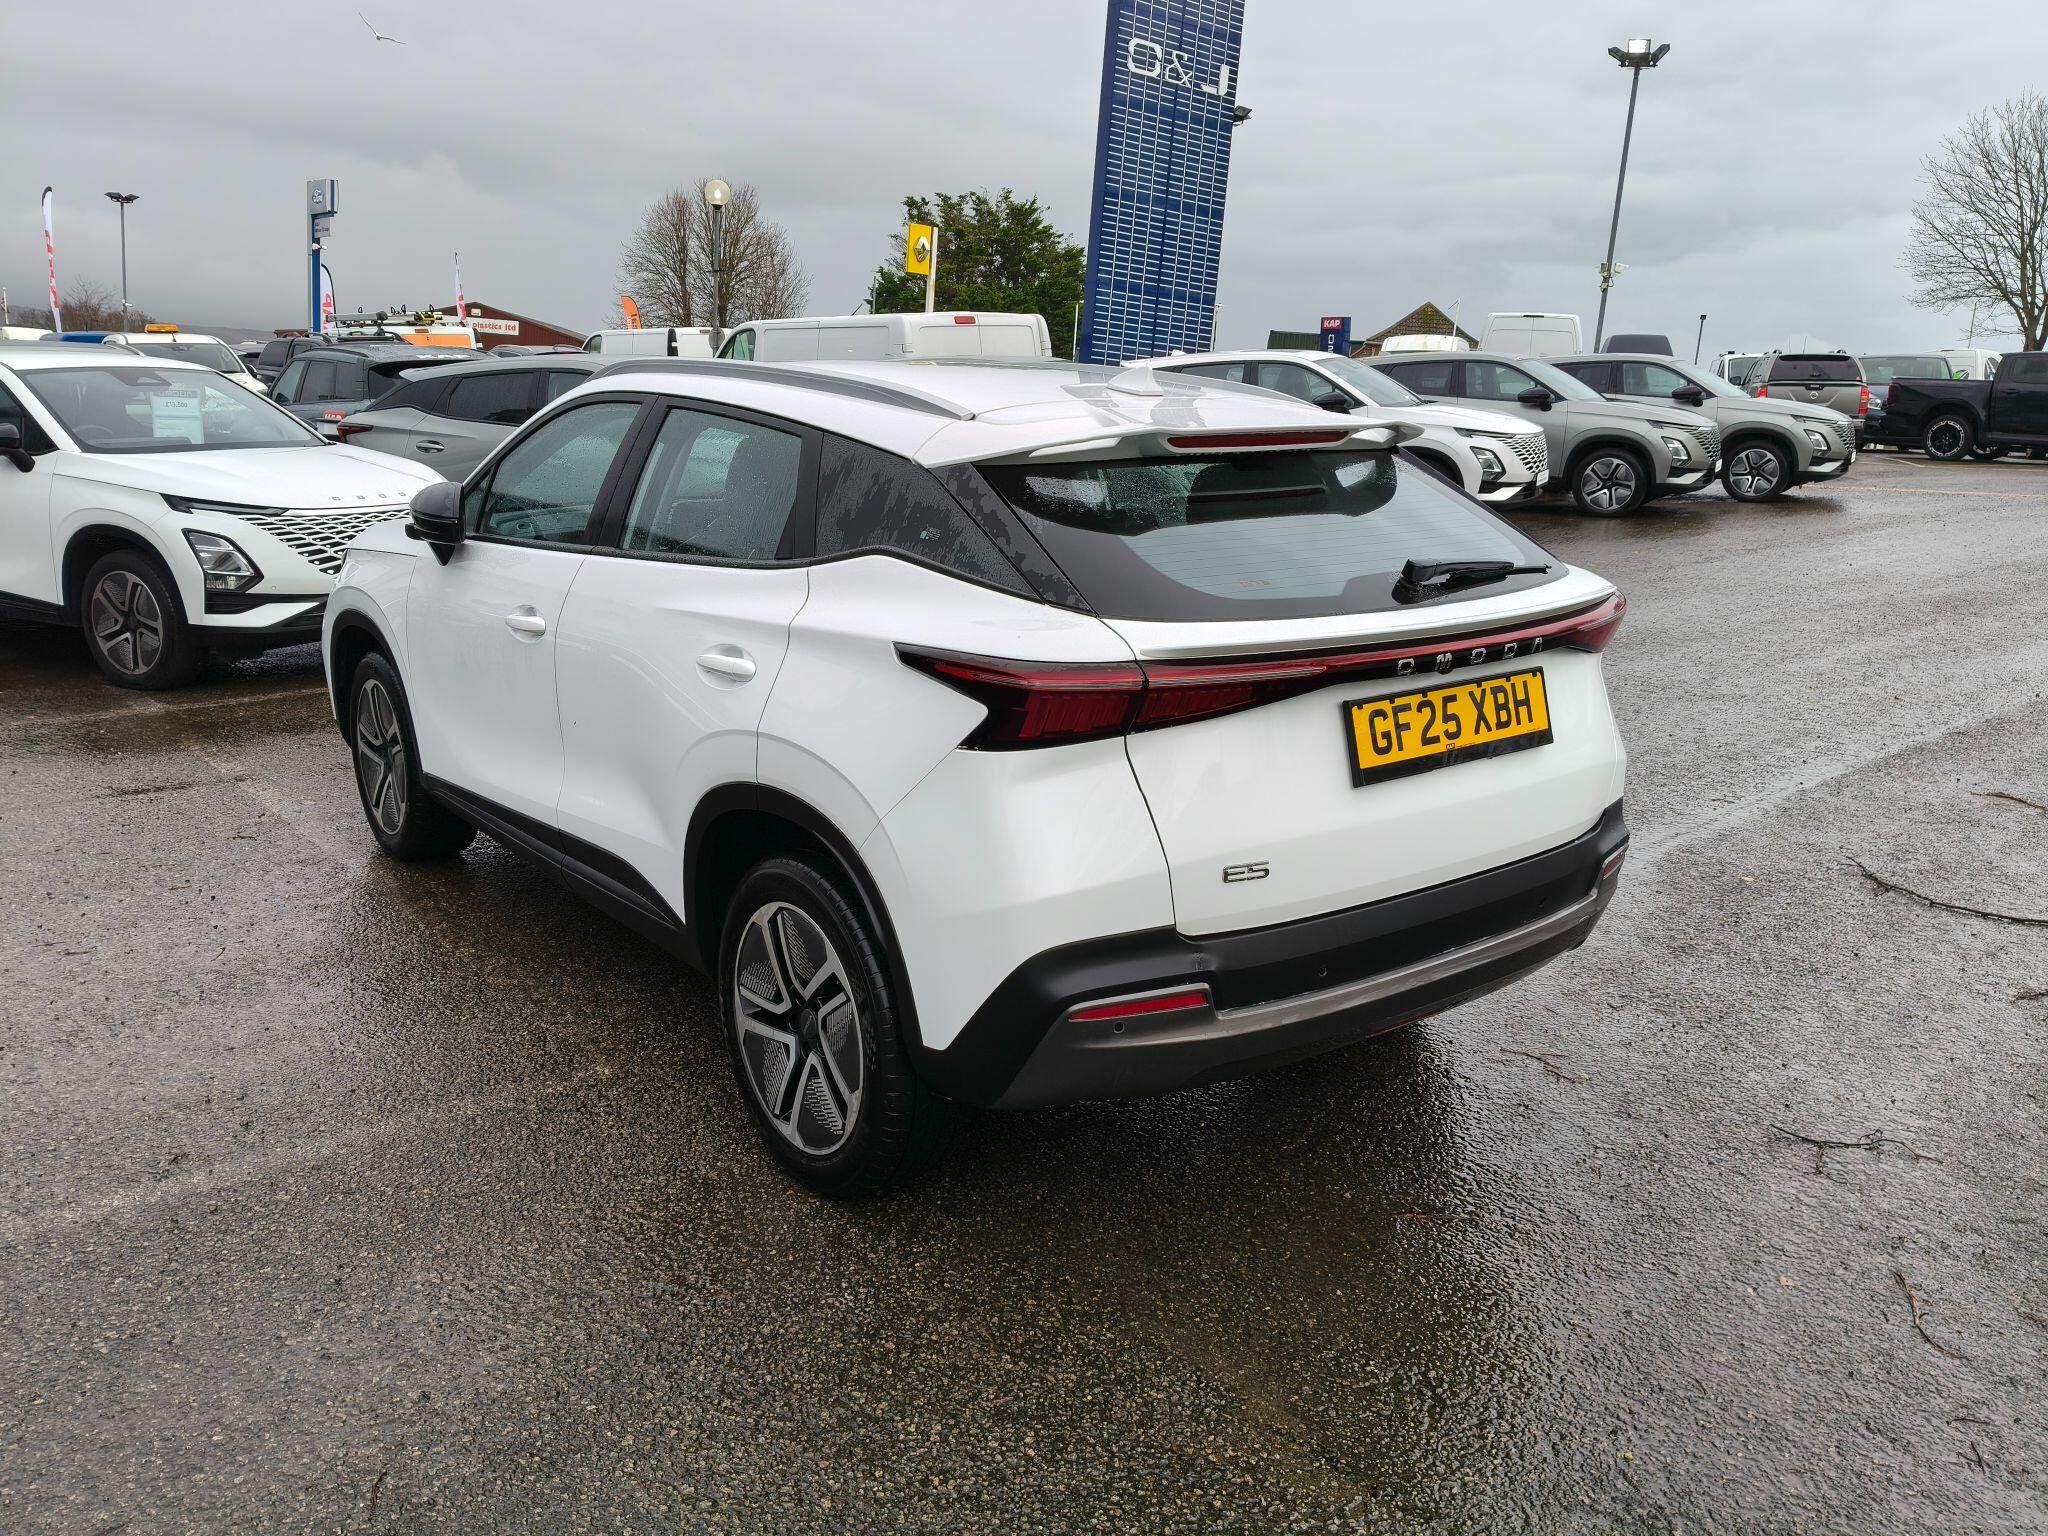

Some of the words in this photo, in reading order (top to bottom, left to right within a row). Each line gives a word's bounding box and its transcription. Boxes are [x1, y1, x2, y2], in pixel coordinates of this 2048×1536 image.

[1323, 319, 1341, 328] KAP
[1367, 693, 1462, 756] GF25
[1468, 679, 1534, 736] XBH
[1222, 859, 1270, 883] E5
